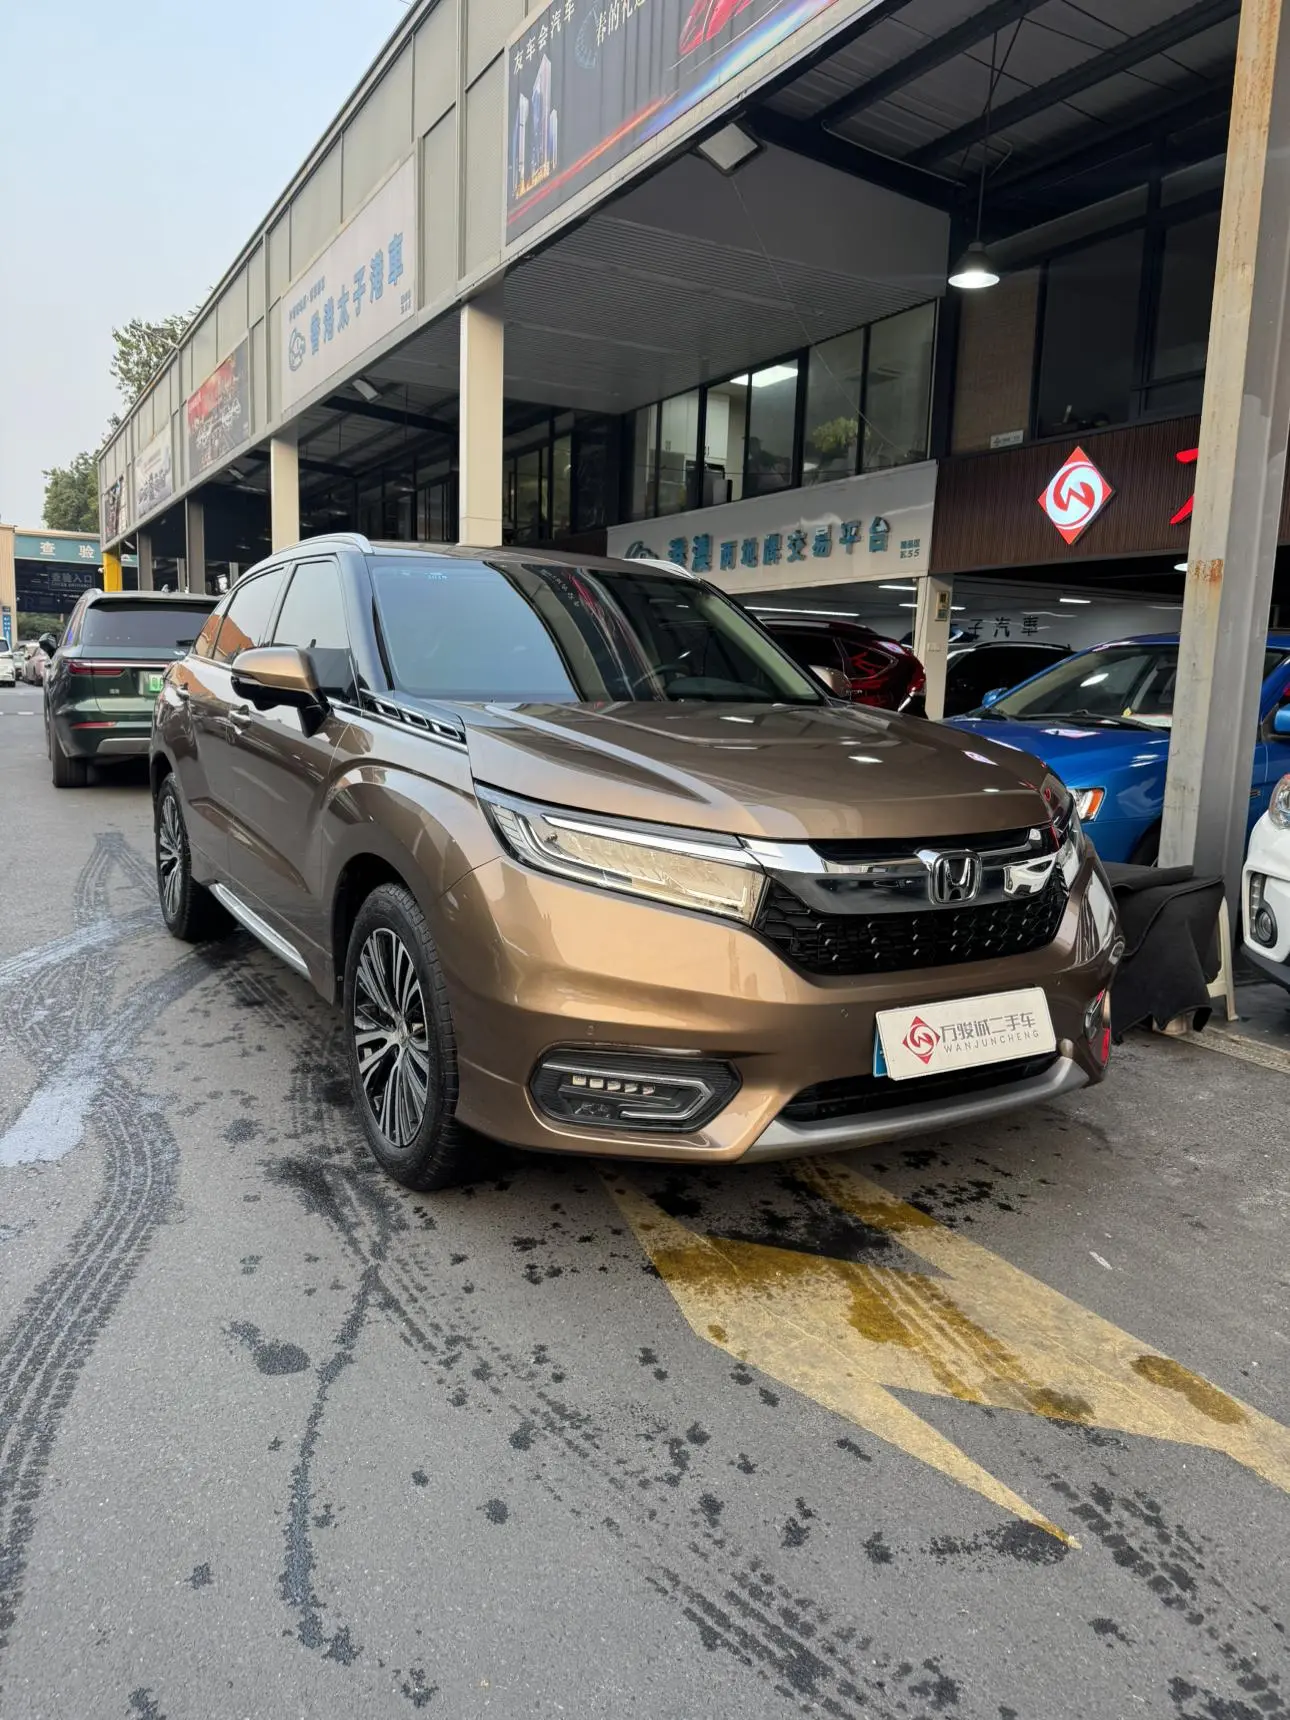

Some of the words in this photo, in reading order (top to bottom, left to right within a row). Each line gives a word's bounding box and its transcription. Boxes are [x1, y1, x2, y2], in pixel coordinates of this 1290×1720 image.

[950, 616, 1039, 638] 子汽車
[940, 1012, 1036, 1042] 万骏诚二手车
[943, 1030, 1040, 1053] WANJUNCHENG
